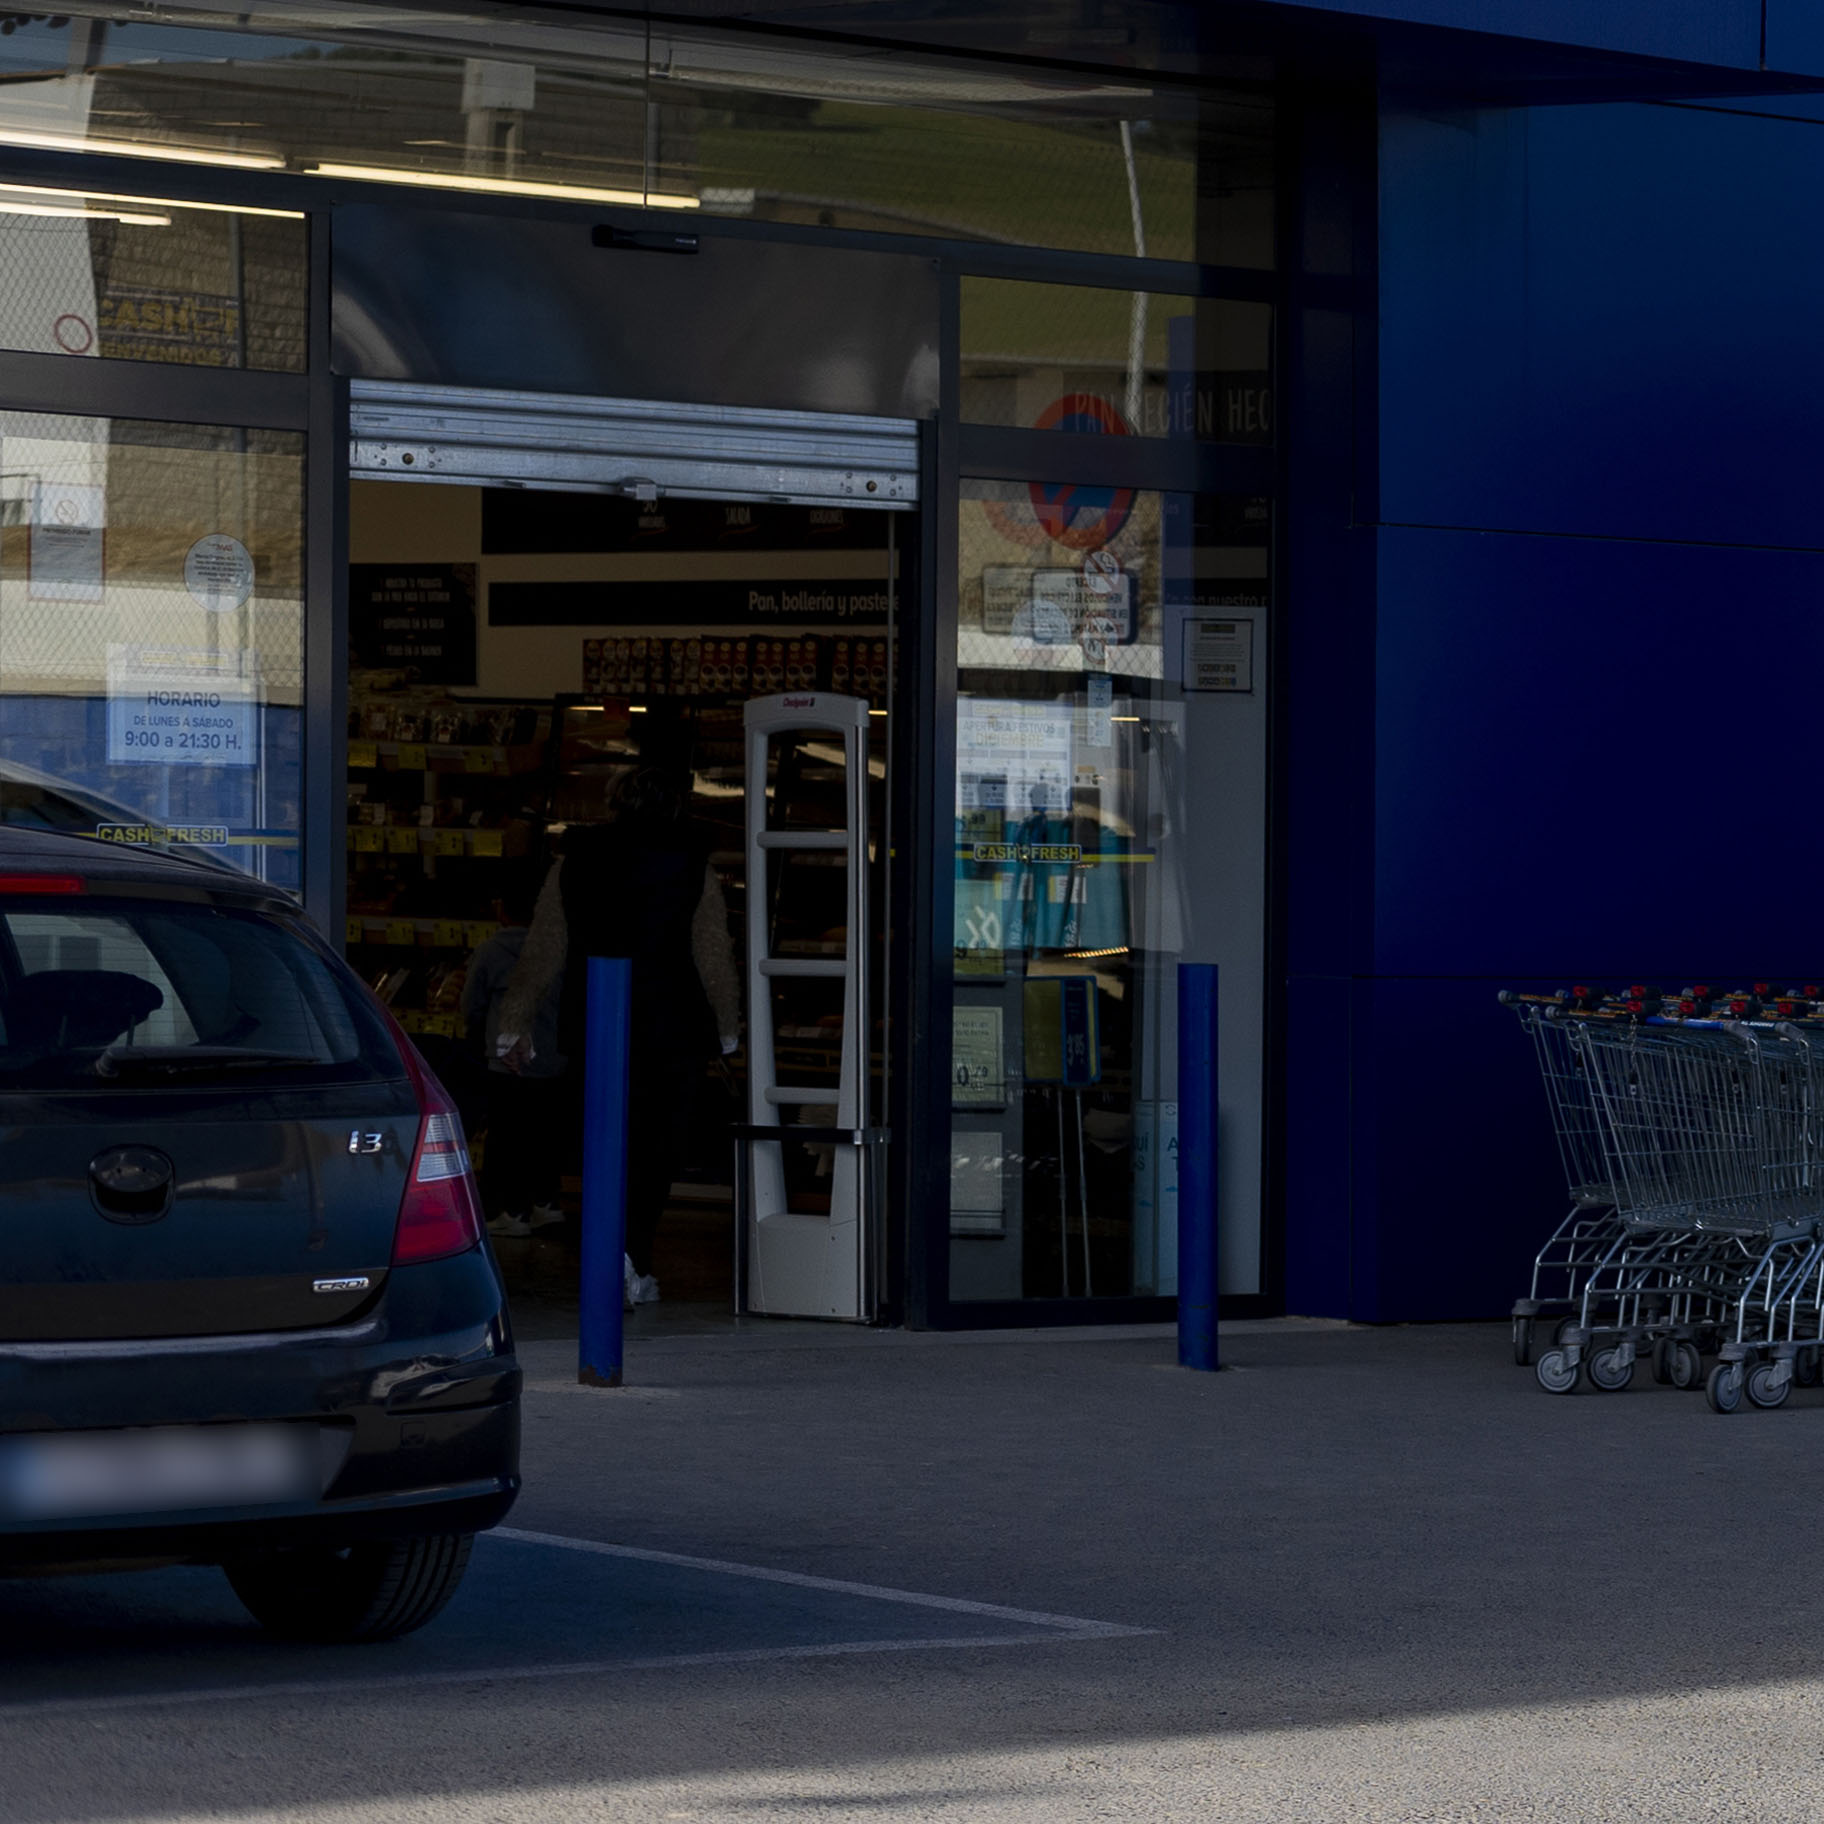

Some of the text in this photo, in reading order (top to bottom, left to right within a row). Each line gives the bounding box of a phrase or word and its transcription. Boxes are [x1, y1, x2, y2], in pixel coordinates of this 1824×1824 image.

[837, 595, 847, 616] y
[147, 691, 221, 708] HORARIO
[134, 715, 147, 726] DE
[149, 716, 180, 727] LUNES
[182, 717, 191, 728] A
[125, 730, 242, 750] 9:00 a 21:30 H.
[100, 826, 225, 843] CASH FRESH
[977, 845, 1080, 860] CASH FRESH
